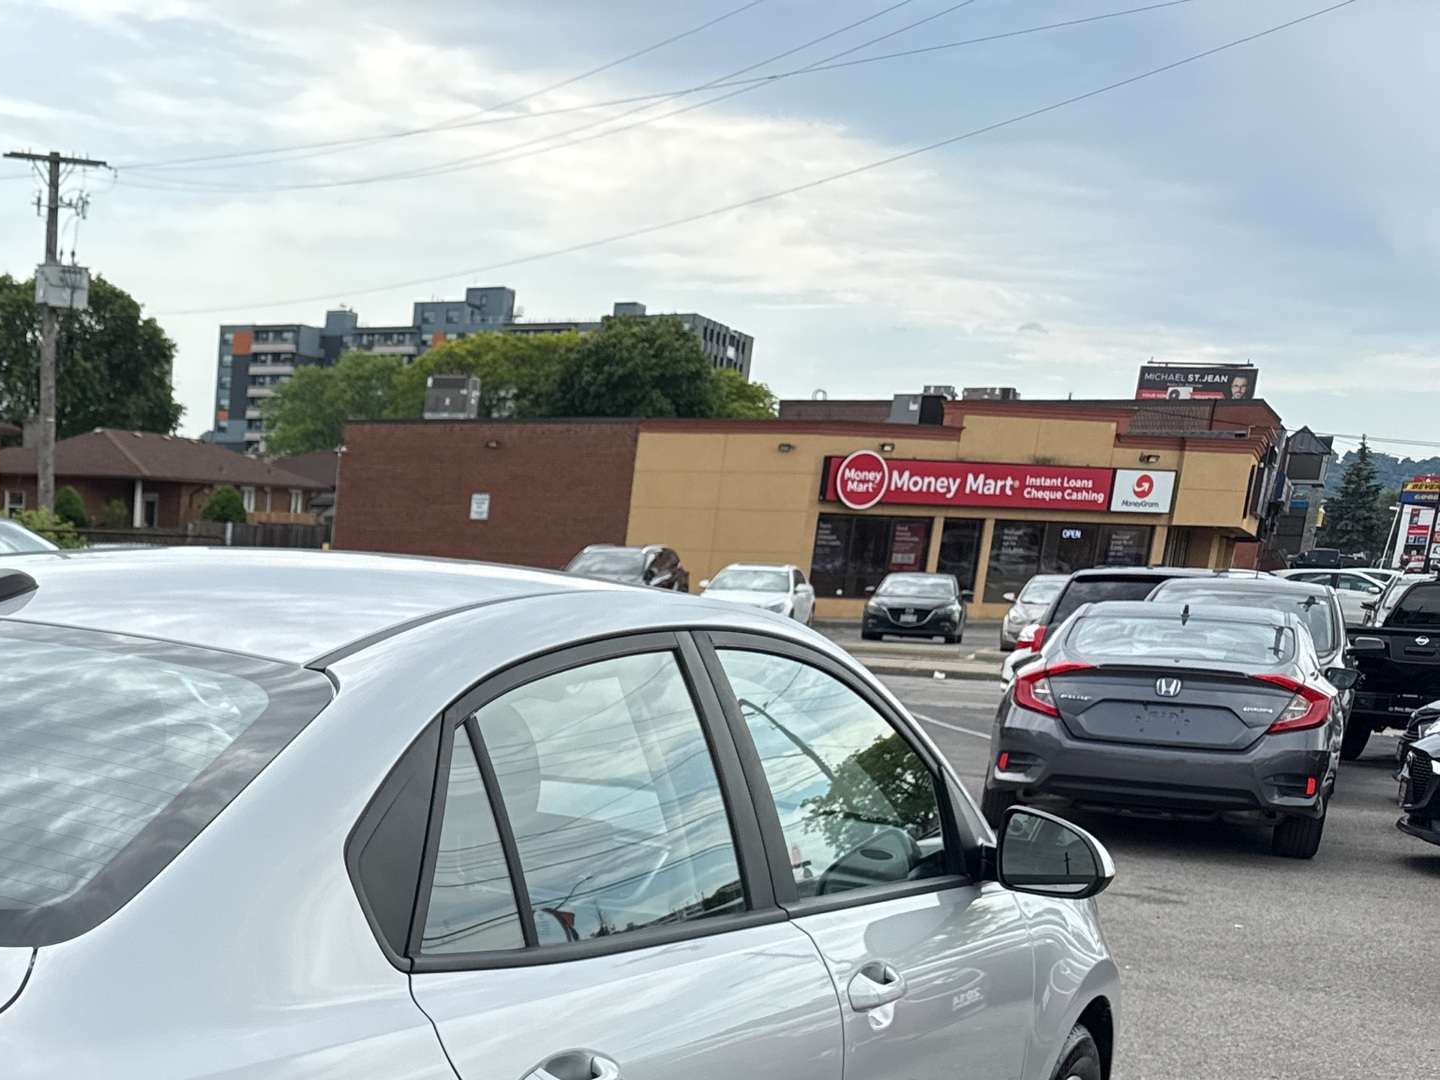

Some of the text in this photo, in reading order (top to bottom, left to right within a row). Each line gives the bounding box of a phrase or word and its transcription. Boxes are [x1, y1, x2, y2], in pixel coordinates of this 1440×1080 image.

[1144, 372, 1185, 382] MICHAEL
[844, 468, 882, 483] Money
[1025, 475, 1093, 488] Instant Loans
[846, 480, 874, 492] Mart
[890, 469, 1013, 498] Money Mart
[1023, 487, 1105, 503] Cheque Cashing
[1120, 500, 1160, 508] MoneyGram
[1061, 528, 1082, 539] OPEN
